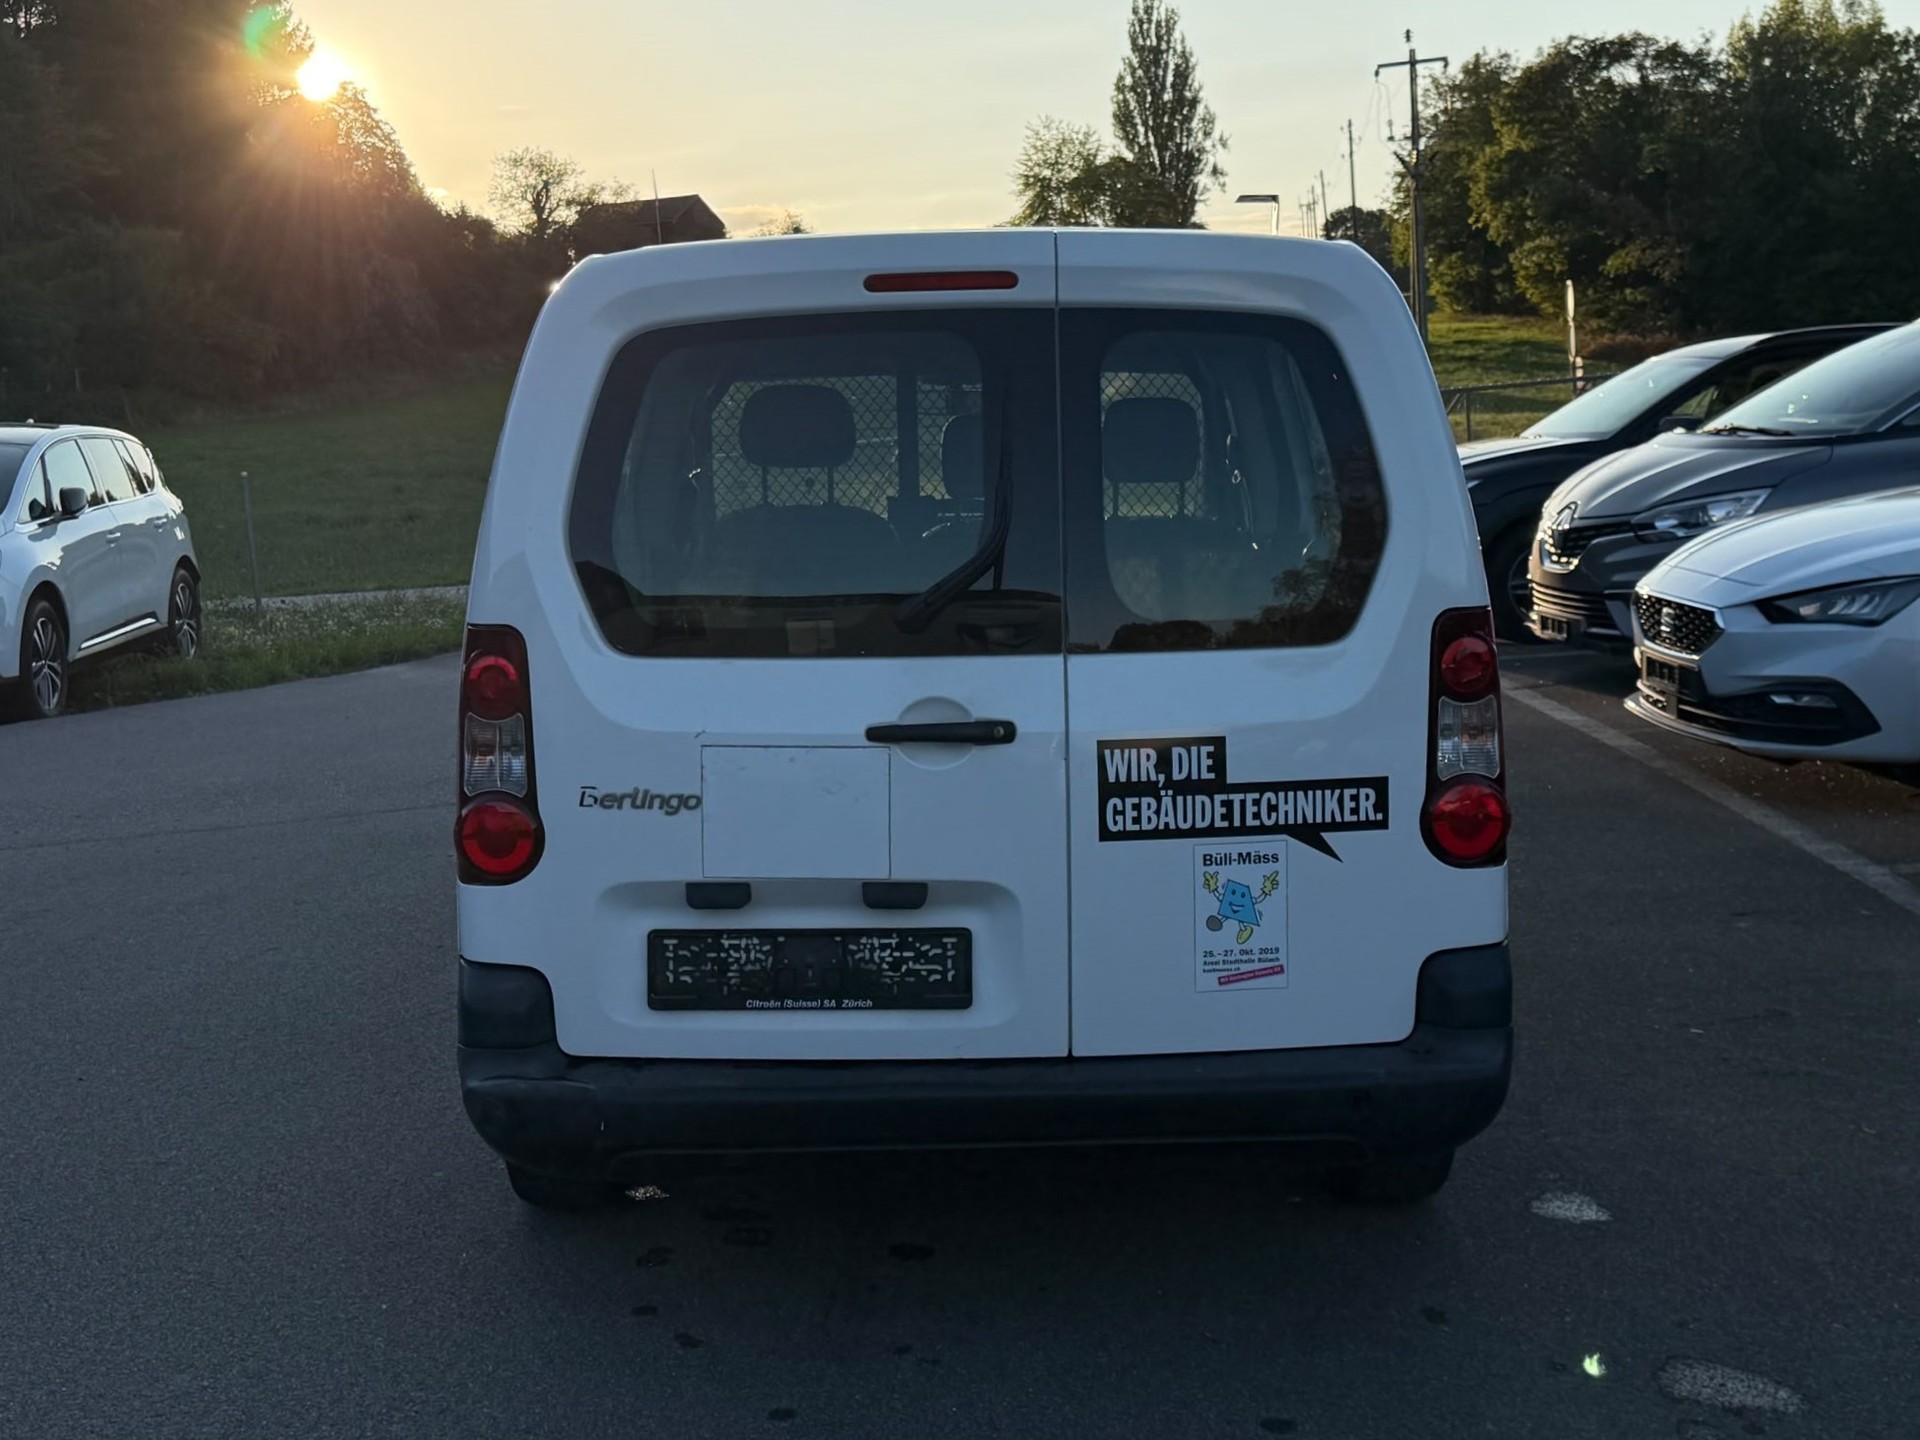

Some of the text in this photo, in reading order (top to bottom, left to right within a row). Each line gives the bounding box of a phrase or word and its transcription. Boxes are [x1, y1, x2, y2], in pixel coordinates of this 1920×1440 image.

[1104, 745, 1216, 788] WIR, DIE
[578, 785, 702, 816] Berlingo
[1105, 788, 1383, 832] GEBÄUDETECHNIKER.
[1202, 850, 1280, 867] Büli-Mäss
[1239, 948, 1256, 956] Okt.
[1258, 947, 1280, 955] 2019
[745, 998, 873, 1008] Citroën (Suisse) SA Zürich
